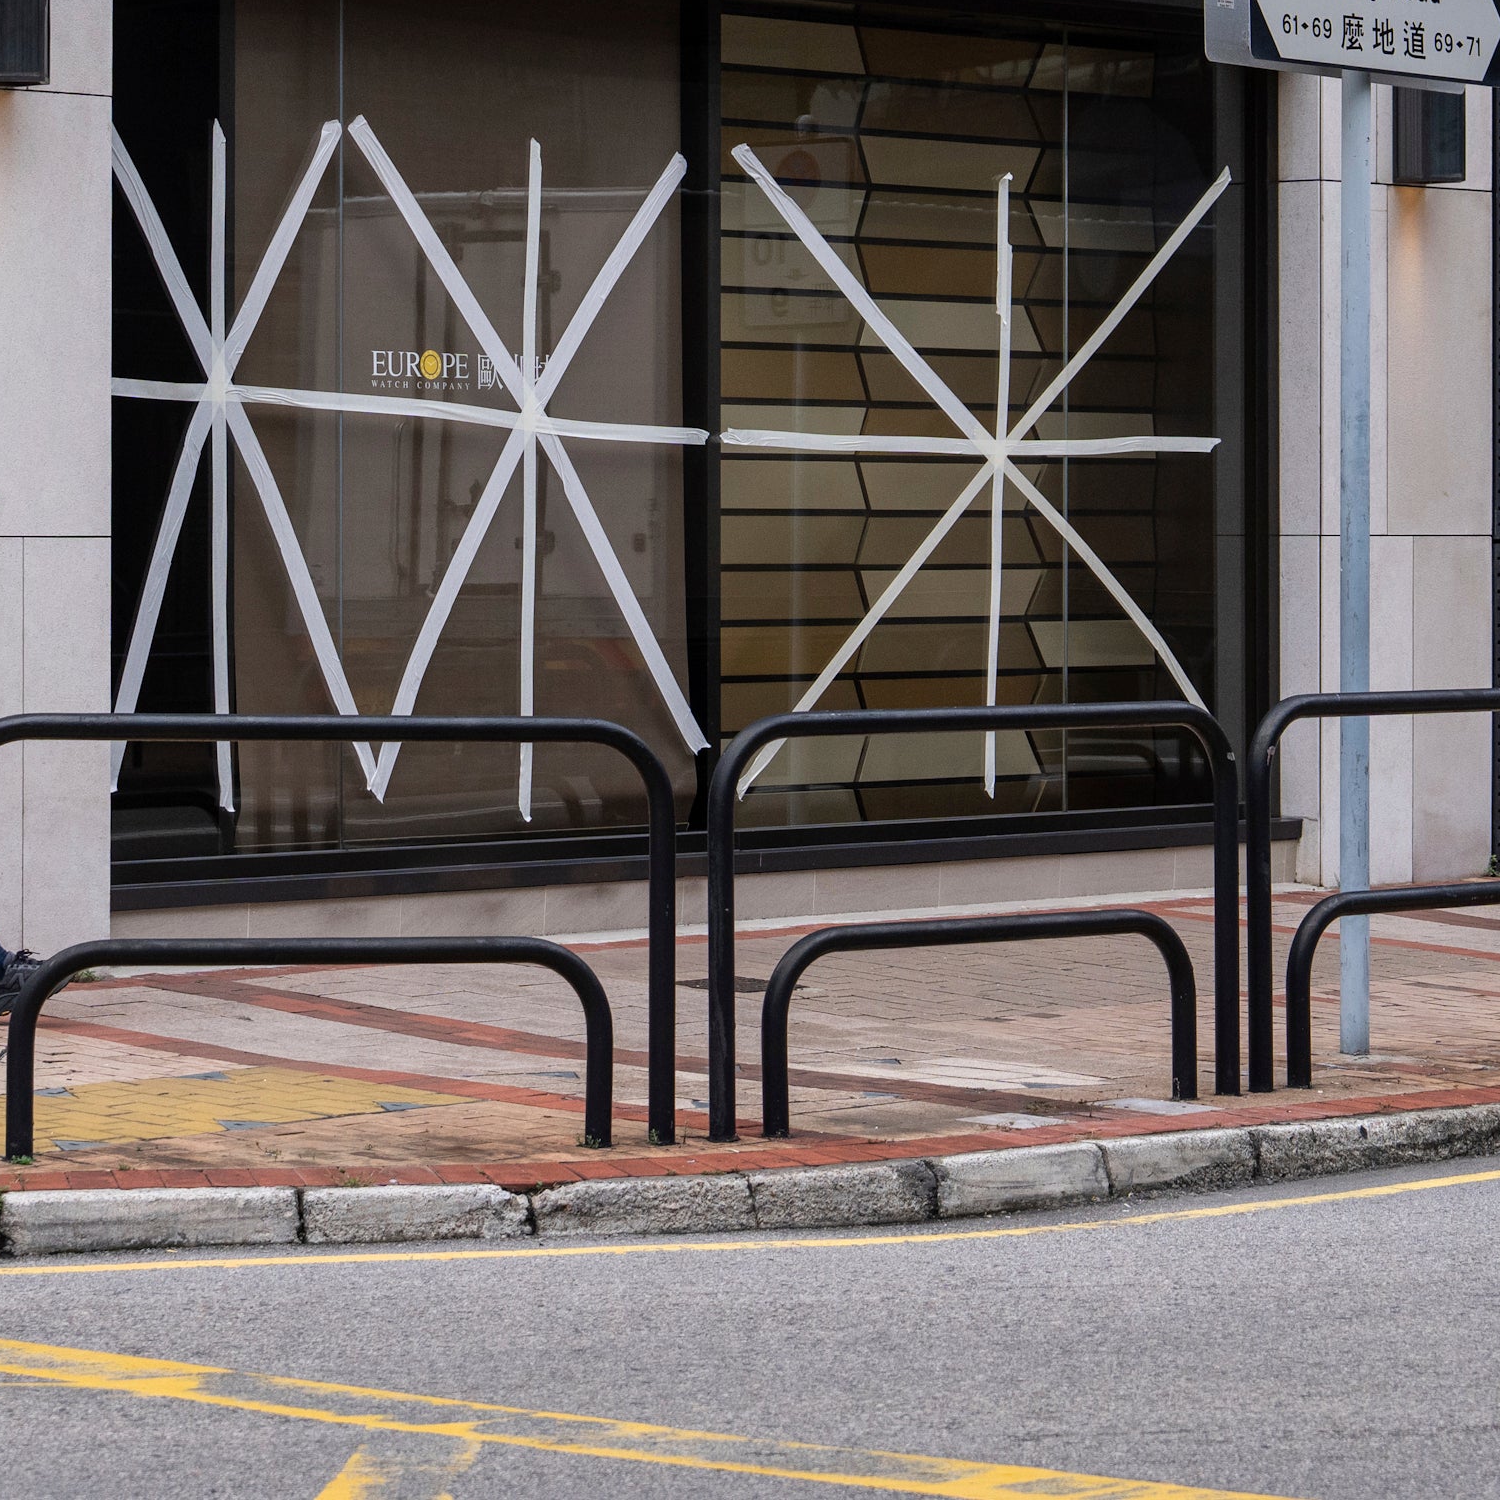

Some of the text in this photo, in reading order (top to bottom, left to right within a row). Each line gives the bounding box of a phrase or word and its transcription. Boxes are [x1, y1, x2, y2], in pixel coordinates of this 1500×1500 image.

[1341, 13, 1427, 60] 麼地道
[371, 380, 470, 391] WATCH COMPANY
